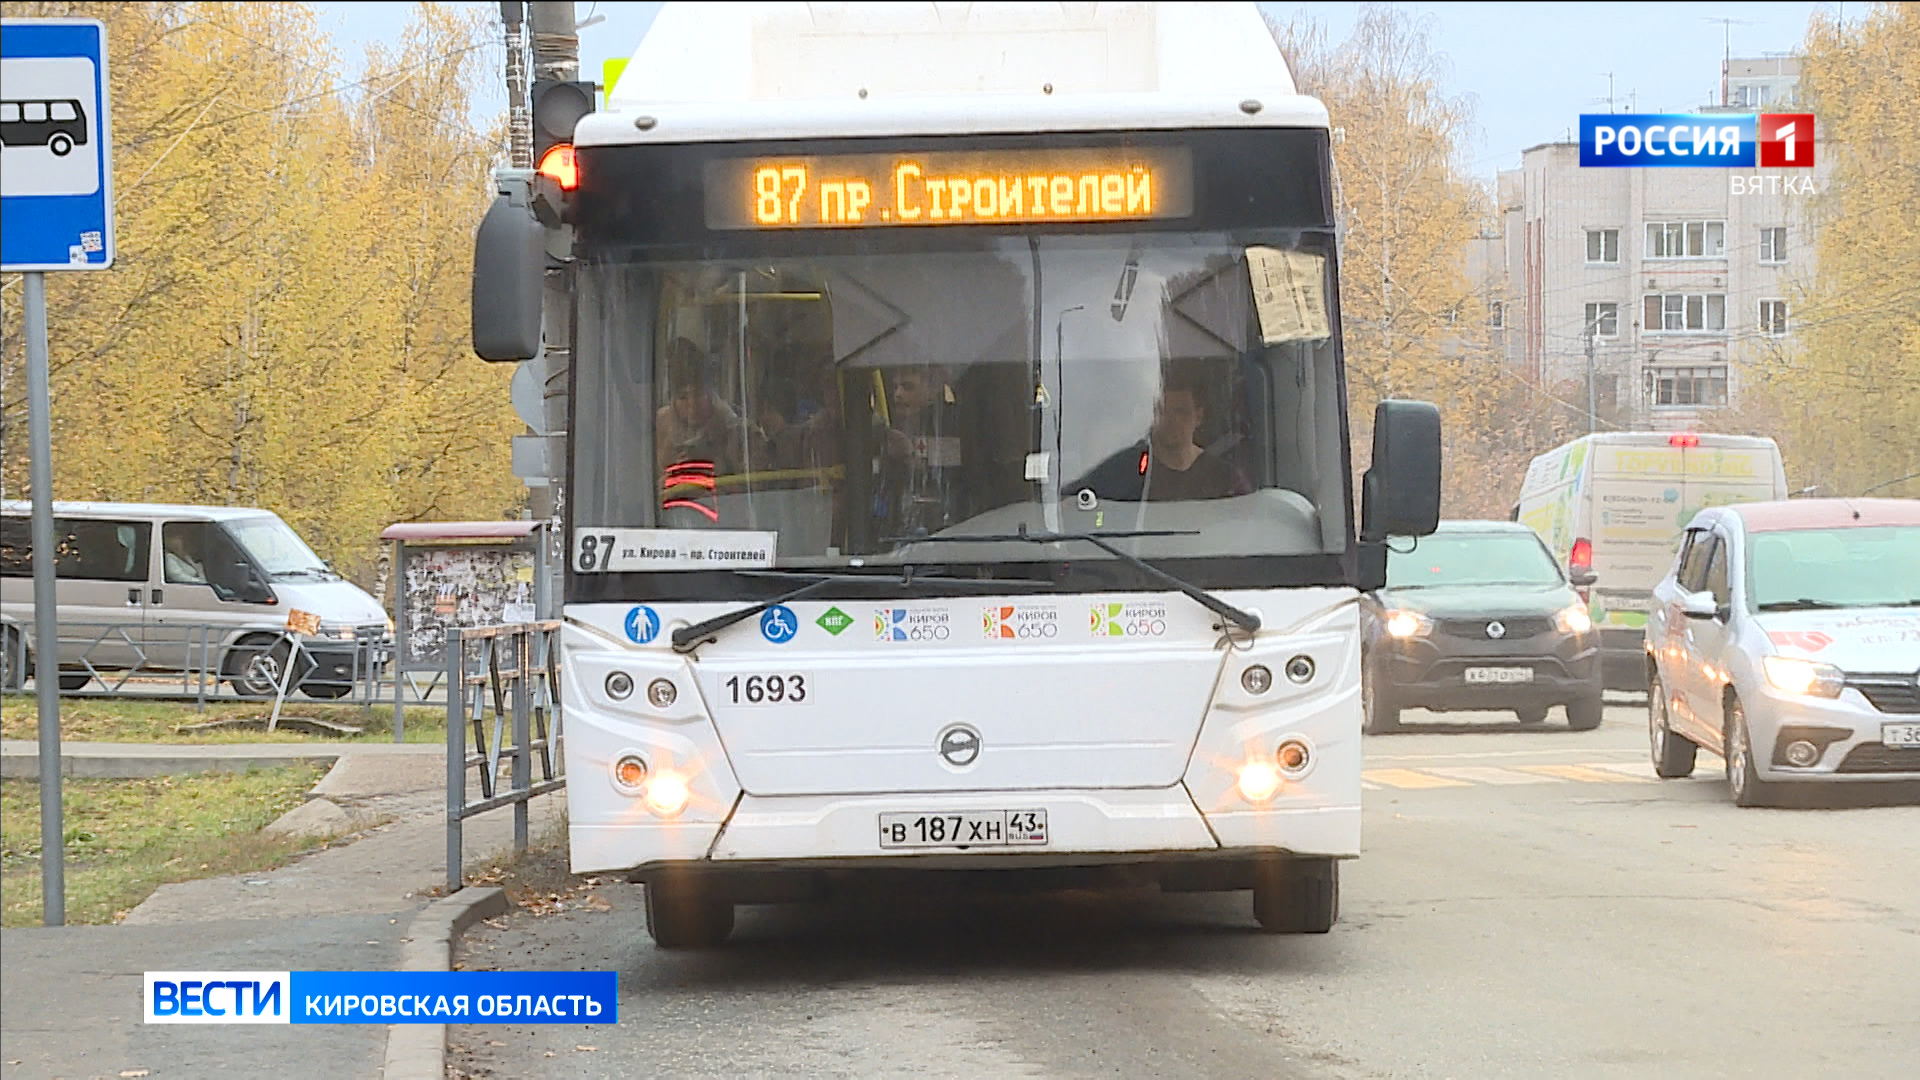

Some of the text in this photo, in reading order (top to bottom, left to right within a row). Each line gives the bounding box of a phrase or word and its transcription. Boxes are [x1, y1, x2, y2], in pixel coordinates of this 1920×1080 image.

[756, 164, 807, 224] 87
[579, 535, 616, 571] 87
[911, 625, 950, 641] 650
[1018, 623, 1057, 639] 650
[1126, 619, 1166, 637] 650
[726, 675, 806, 704] 1693
